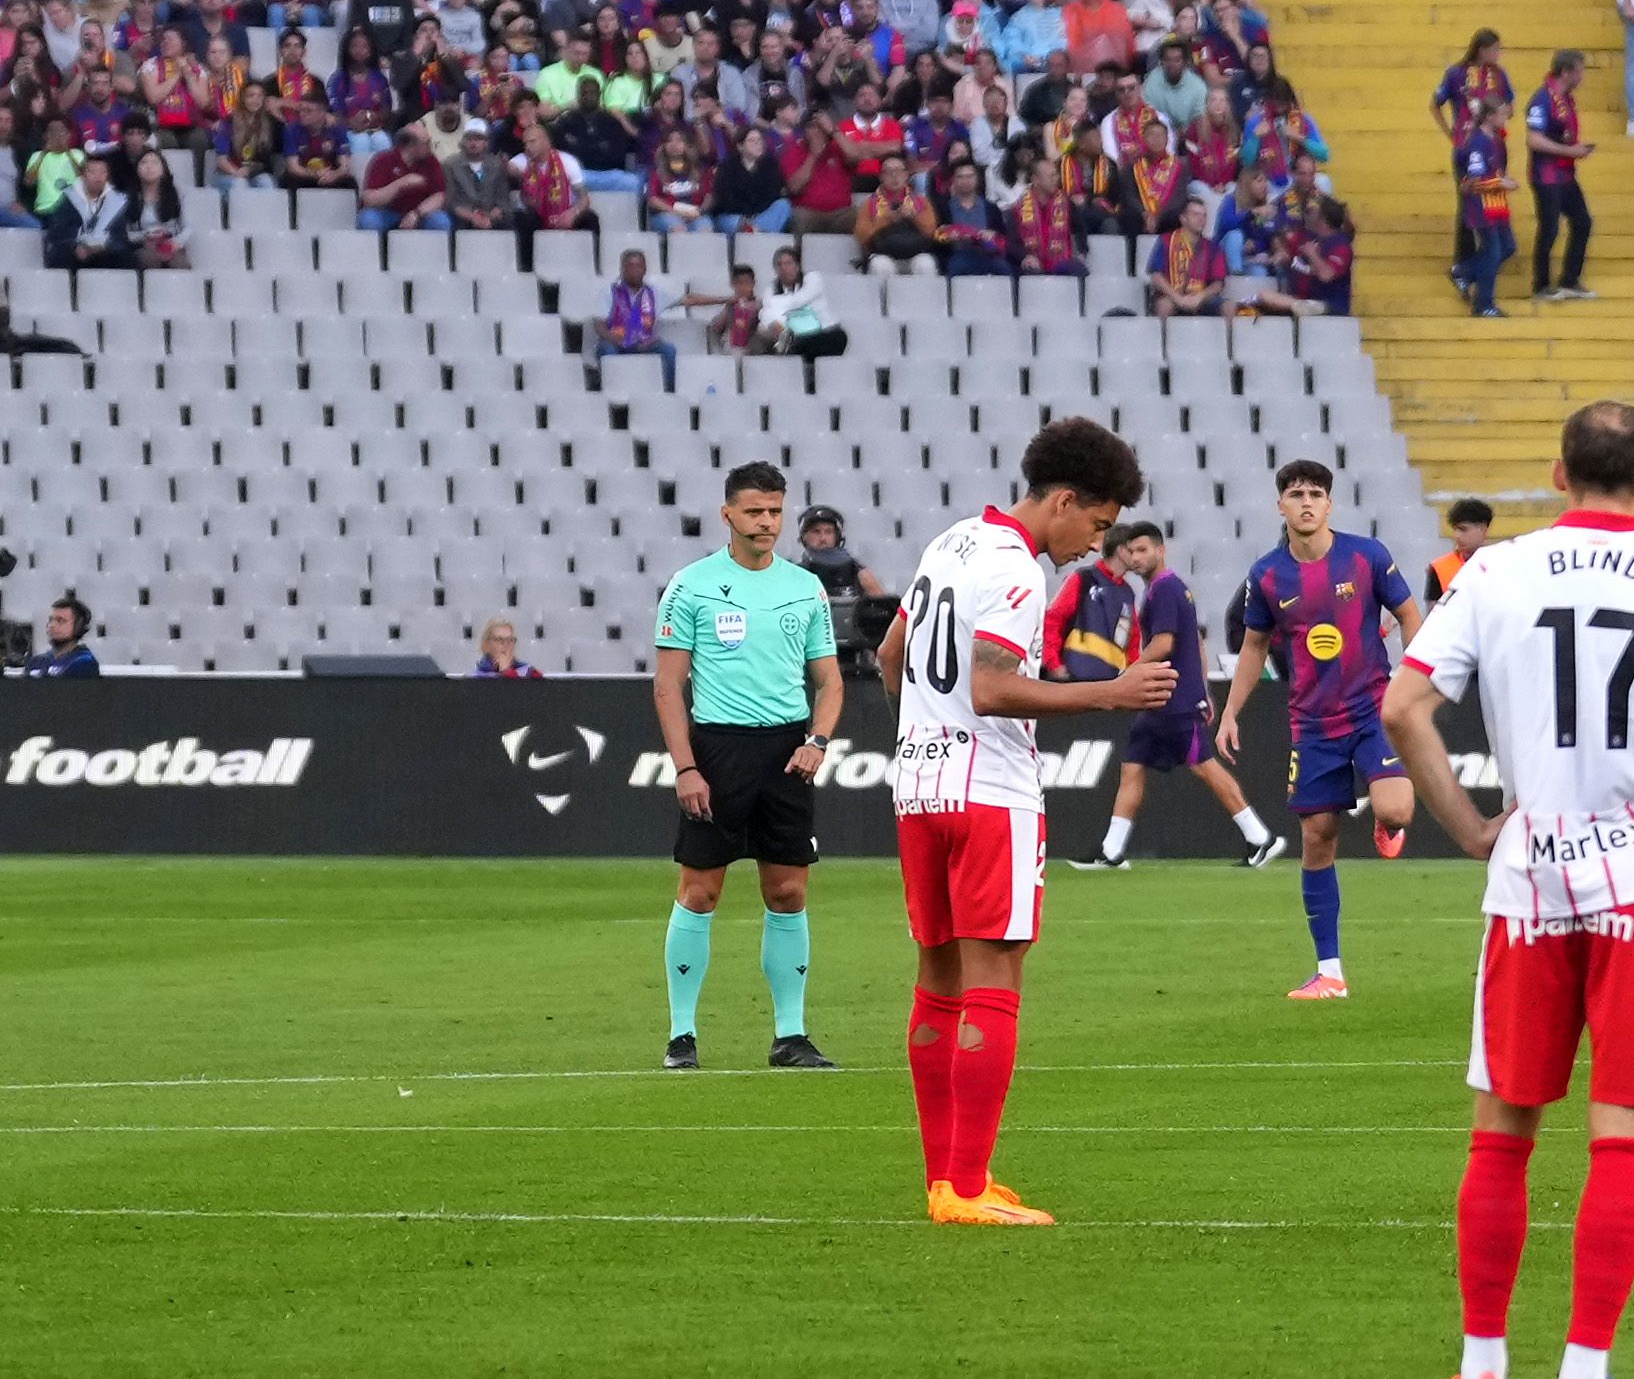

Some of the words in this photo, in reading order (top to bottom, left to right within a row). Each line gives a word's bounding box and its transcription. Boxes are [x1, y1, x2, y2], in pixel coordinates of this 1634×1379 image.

[718, 614, 742, 624] FIFA
[902, 574, 957, 694] 20
[5, 735, 315, 786] football
[1288, 750, 1299, 783] 5
